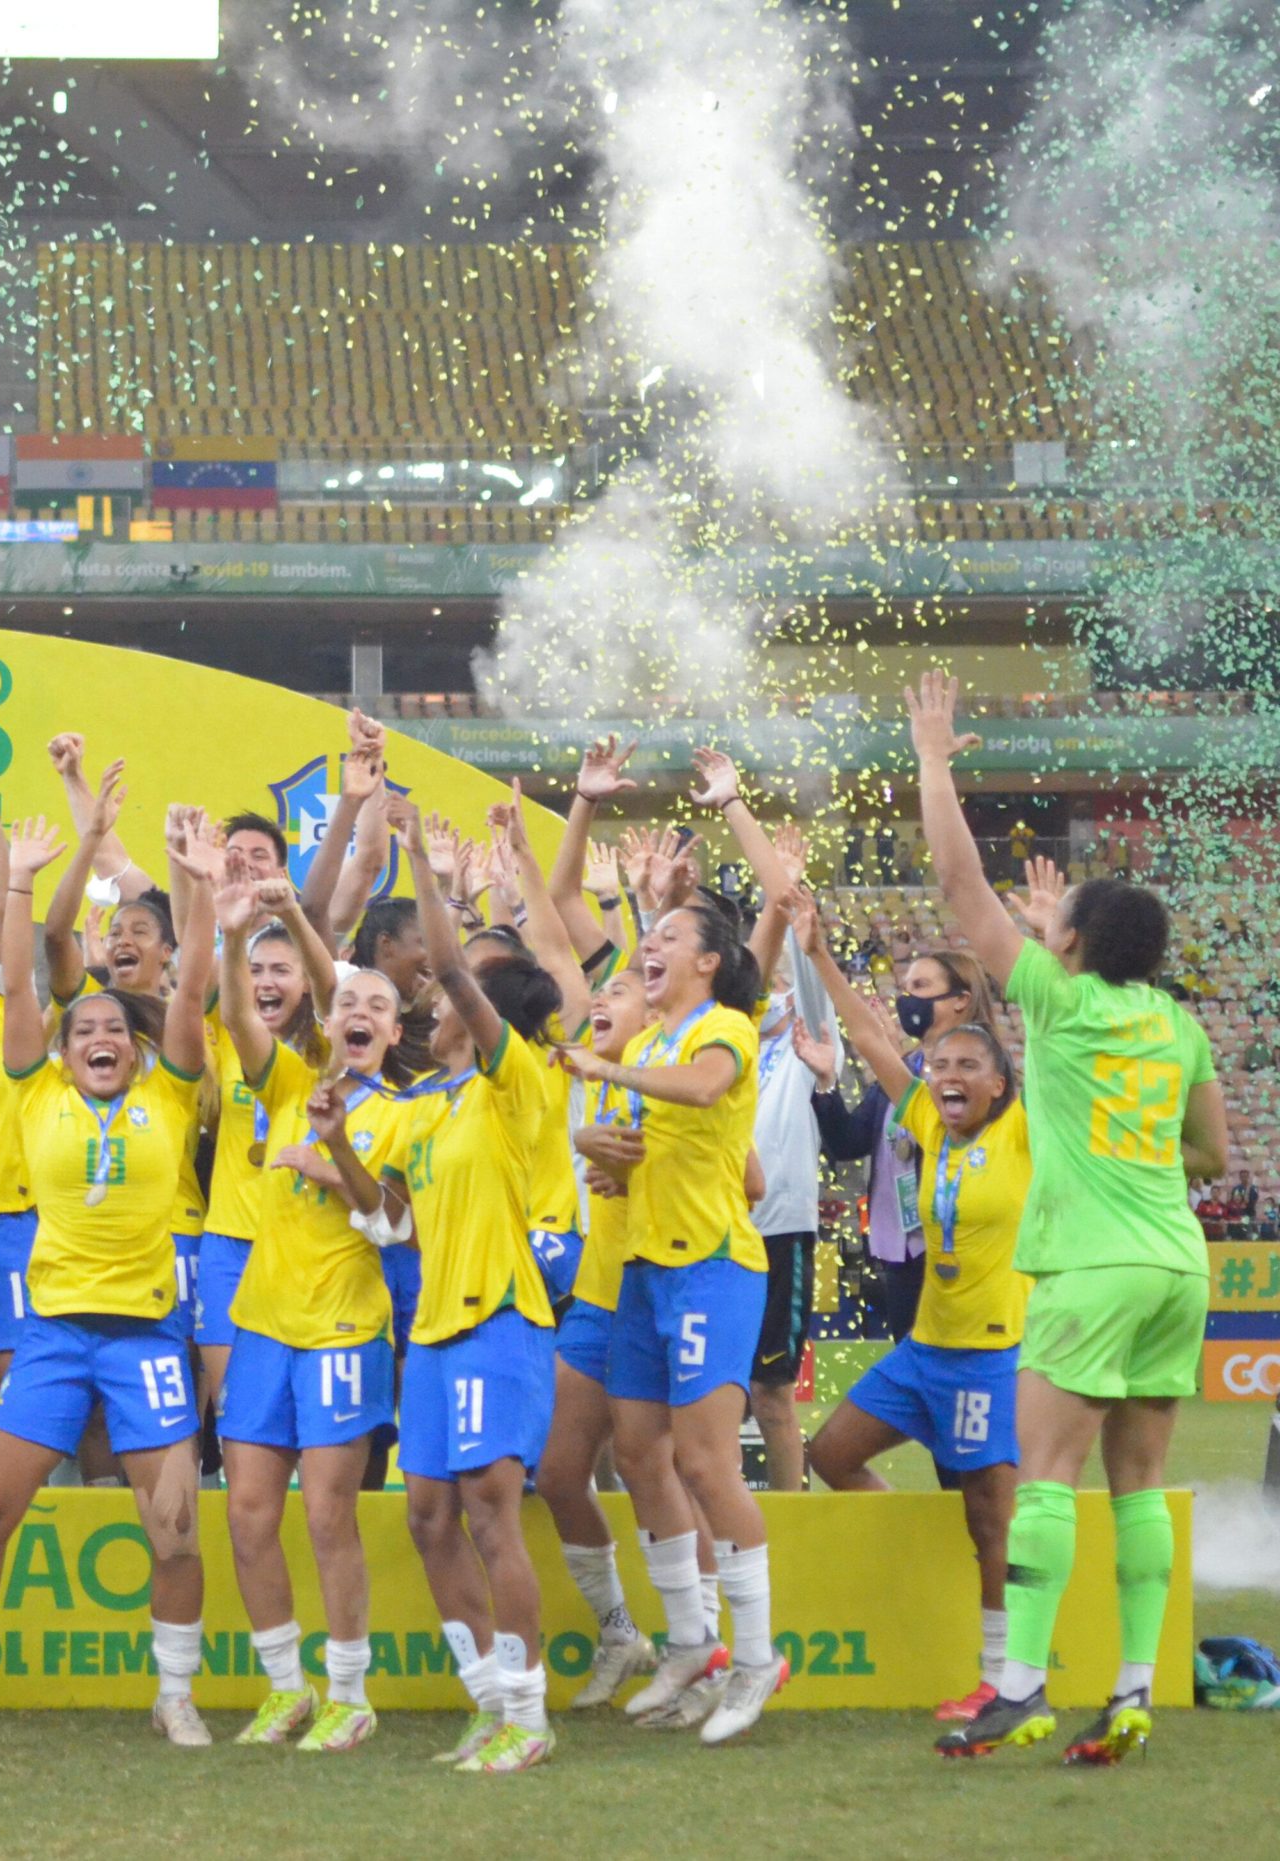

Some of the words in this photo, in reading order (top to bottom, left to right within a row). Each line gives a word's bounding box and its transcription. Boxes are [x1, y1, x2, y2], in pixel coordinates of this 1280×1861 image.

[61, 562, 75, 577] A
[115, 562, 171, 577] contra
[272, 560, 352, 578] também.
[451, 747, 542, 764] Vacine-se.
[1090, 1053, 1183, 1167] 22
[679, 1313, 707, 1366] 5
[140, 1355, 187, 1410] 13
[322, 1353, 361, 1406] 14
[954, 1391, 991, 1442] 18
[772, 1630, 875, 1676] 021
